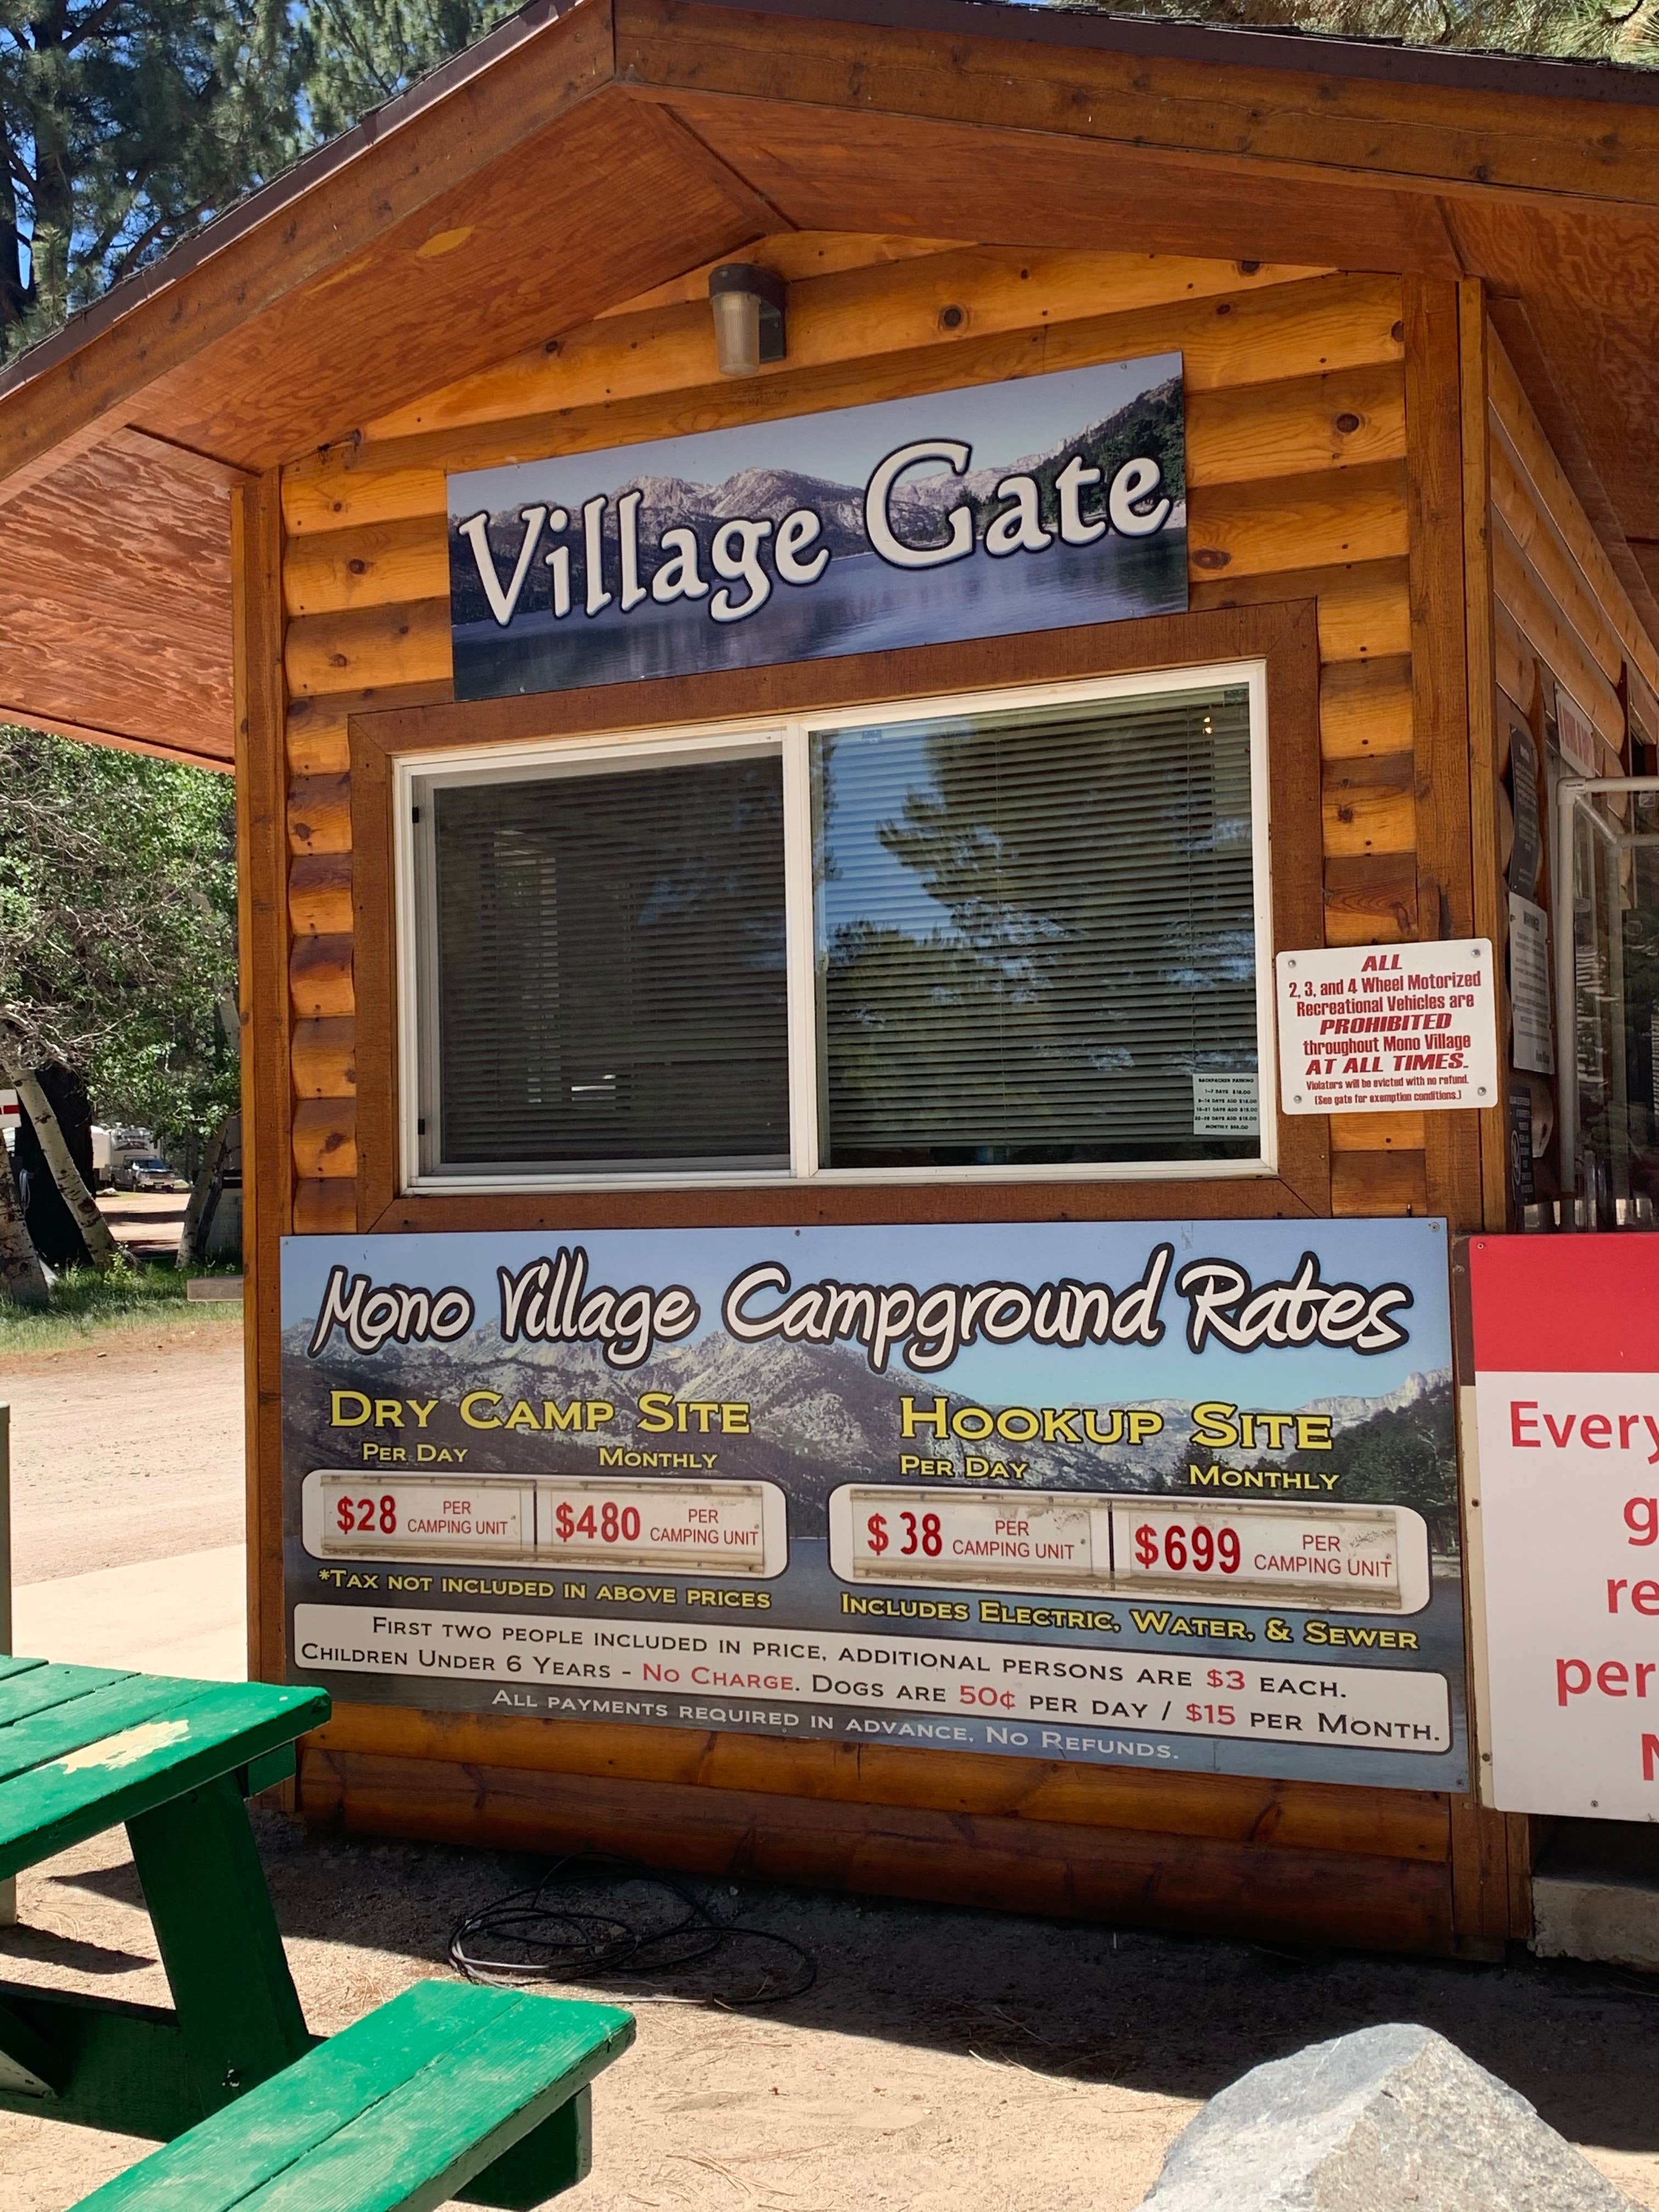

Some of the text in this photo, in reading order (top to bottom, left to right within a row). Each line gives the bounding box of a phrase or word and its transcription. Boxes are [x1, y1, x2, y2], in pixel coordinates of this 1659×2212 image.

[456, 438, 1173, 624] Village Gate
[1361, 954, 1402, 972] ALL
[1289, 970, 1481, 998] 2, 3, and 4 Wheel Motorized
[1296, 994, 1474, 1017] Recreational Vehicles are
[1319, 1013, 1452, 1035] PROHIBITED
[1303, 1034, 1471, 1056] throughout Mono Village
[1305, 1053, 1469, 1075] AT ALL TIMES.
[1306, 1080, 1342, 1090] Violators
[1345, 1079, 1359, 1088] will
[1362, 1079, 1371, 1087] be
[1373, 1076, 1403, 1087] evicted
[1406, 1075, 1425, 1086] with
[1439, 1074, 1469, 1084] refund.
[1334, 1094, 1352, 1105] gate
[1355, 1094, 1367, 1103] for
[1369, 1092, 1412, 1103] exemption
[308, 1242, 1414, 1373] Mono Village Campground Rates
[336, 1494, 397, 1534] $28
[443, 1500, 472, 1514] PER
[687, 1509, 719, 1524] PER
[408, 1518, 508, 1536] CAMPING UNIT
[555, 1501, 641, 1543] $480
[995, 1520, 1030, 1537] PER
[650, 1526, 759, 1546] CAMPING UNIT
[1302, 1534, 1341, 1552] PER
[952, 1539, 1075, 1560] CAMPING UNIT
[1135, 1523, 1242, 1574] $699
[1254, 1553, 1392, 1578] CAMPING UNIT
[388, 1575, 433, 1592] NOT
[442, 1578, 554, 1598] INCLUDED
[563, 1583, 586, 1599] IN
[596, 1584, 677, 1605] ABOVE
[687, 1590, 772, 1609] PRICES
[1265, 1617, 1294, 1641] &
[442, 1622, 492, 1640] TWO
[501, 1626, 583, 1646] PEOPLE
[593, 1631, 708, 1653] INCLUDED
[719, 1639, 741, 1655] IN
[753, 1641, 827, 1661] PRICE,
[838, 1645, 990, 1672] ADDITIONAL
[1002, 1658, 1124, 1682] PERSONS
[1137, 1667, 1193, 1688] ARE
[1206, 1669, 1246, 1692] $3
[1260, 1677, 1347, 1699] EACH.
[506, 1655, 523, 1673] 6
[896, 1682, 947, 1703] ARE
[958, 1684, 1017, 1711] 50¢
[1029, 1692, 1079, 1714] PER
[1091, 1699, 1148, 1721] DAY
[1161, 1700, 1172, 1722] /
[1185, 1702, 1237, 1726] $15
[1250, 1709, 1302, 1732] PER
[1556, 1658, 1656, 1707] per
[548, 1696, 668, 1718] PAYMENTS
[679, 1704, 800, 1728] REQUIRED
[810, 1716, 834, 1730] IN
